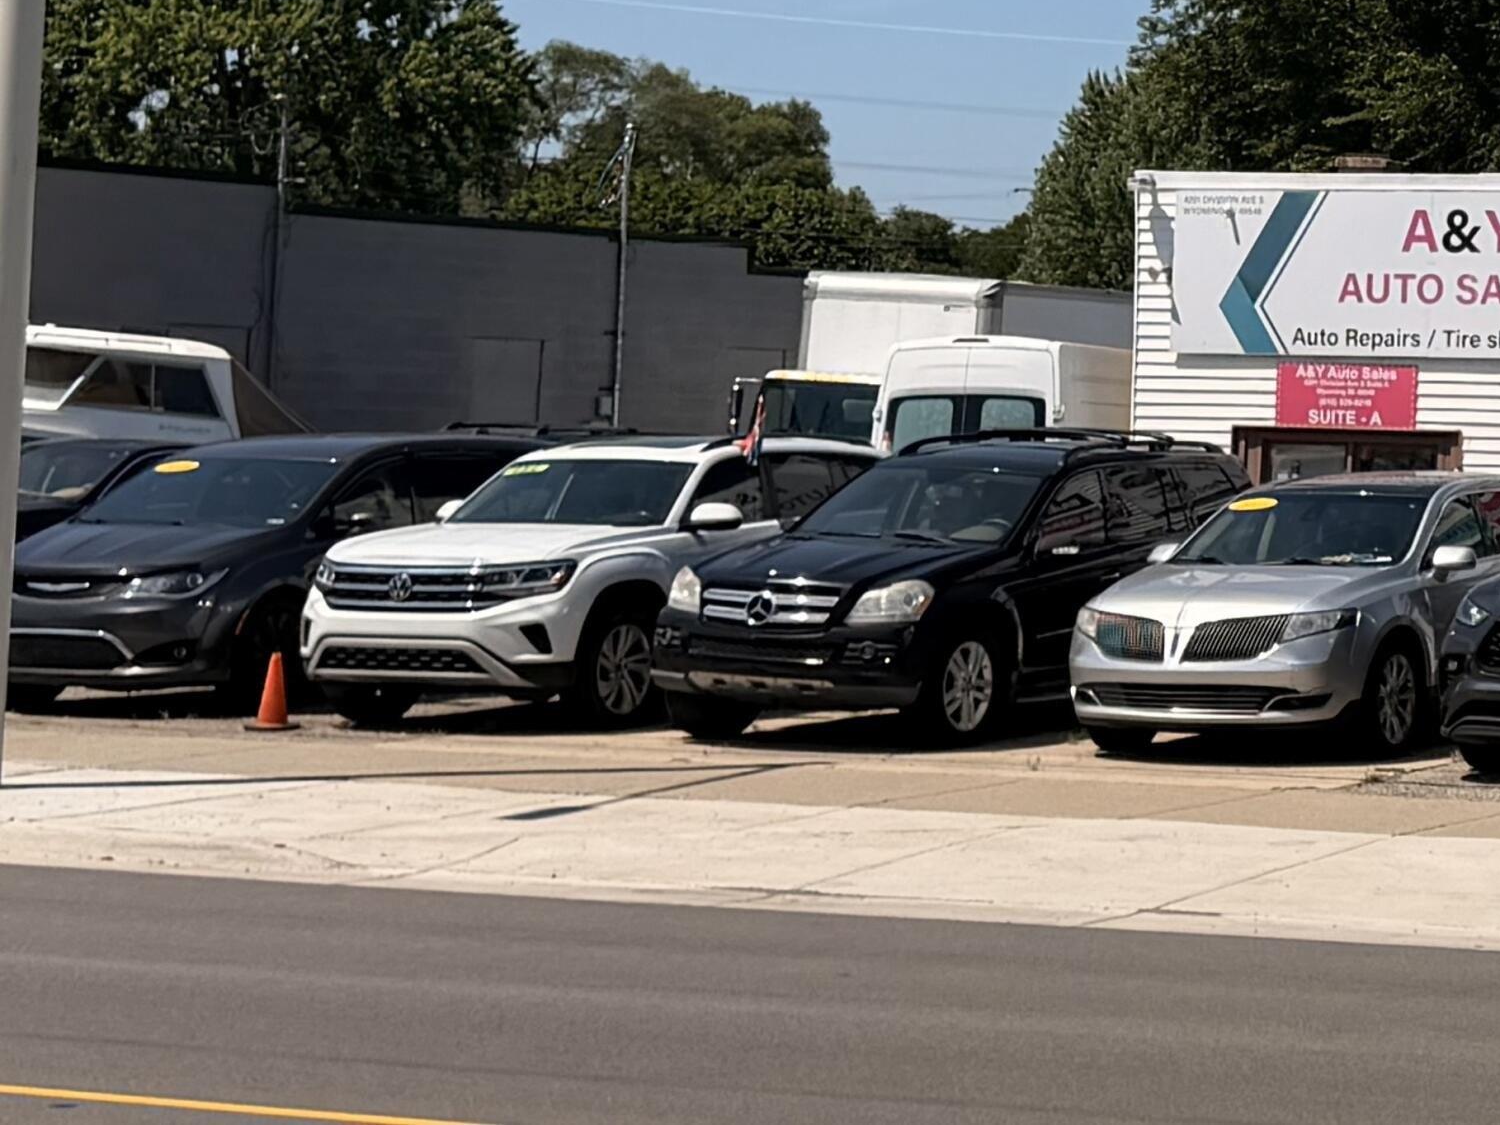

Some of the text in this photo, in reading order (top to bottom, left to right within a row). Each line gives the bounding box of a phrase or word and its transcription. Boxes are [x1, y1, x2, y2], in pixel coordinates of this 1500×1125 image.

[1338, 273, 1444, 305] AUTO
[1292, 327, 1339, 347] Auto
[1346, 328, 1421, 351] Repairs
[1427, 329, 1436, 349] /
[1443, 329, 1481, 349] Tire
[1296, 364, 1397, 380] A&Y Auto Sales
[1308, 409, 1356, 425] SUITE
[1369, 411, 1382, 426] A
